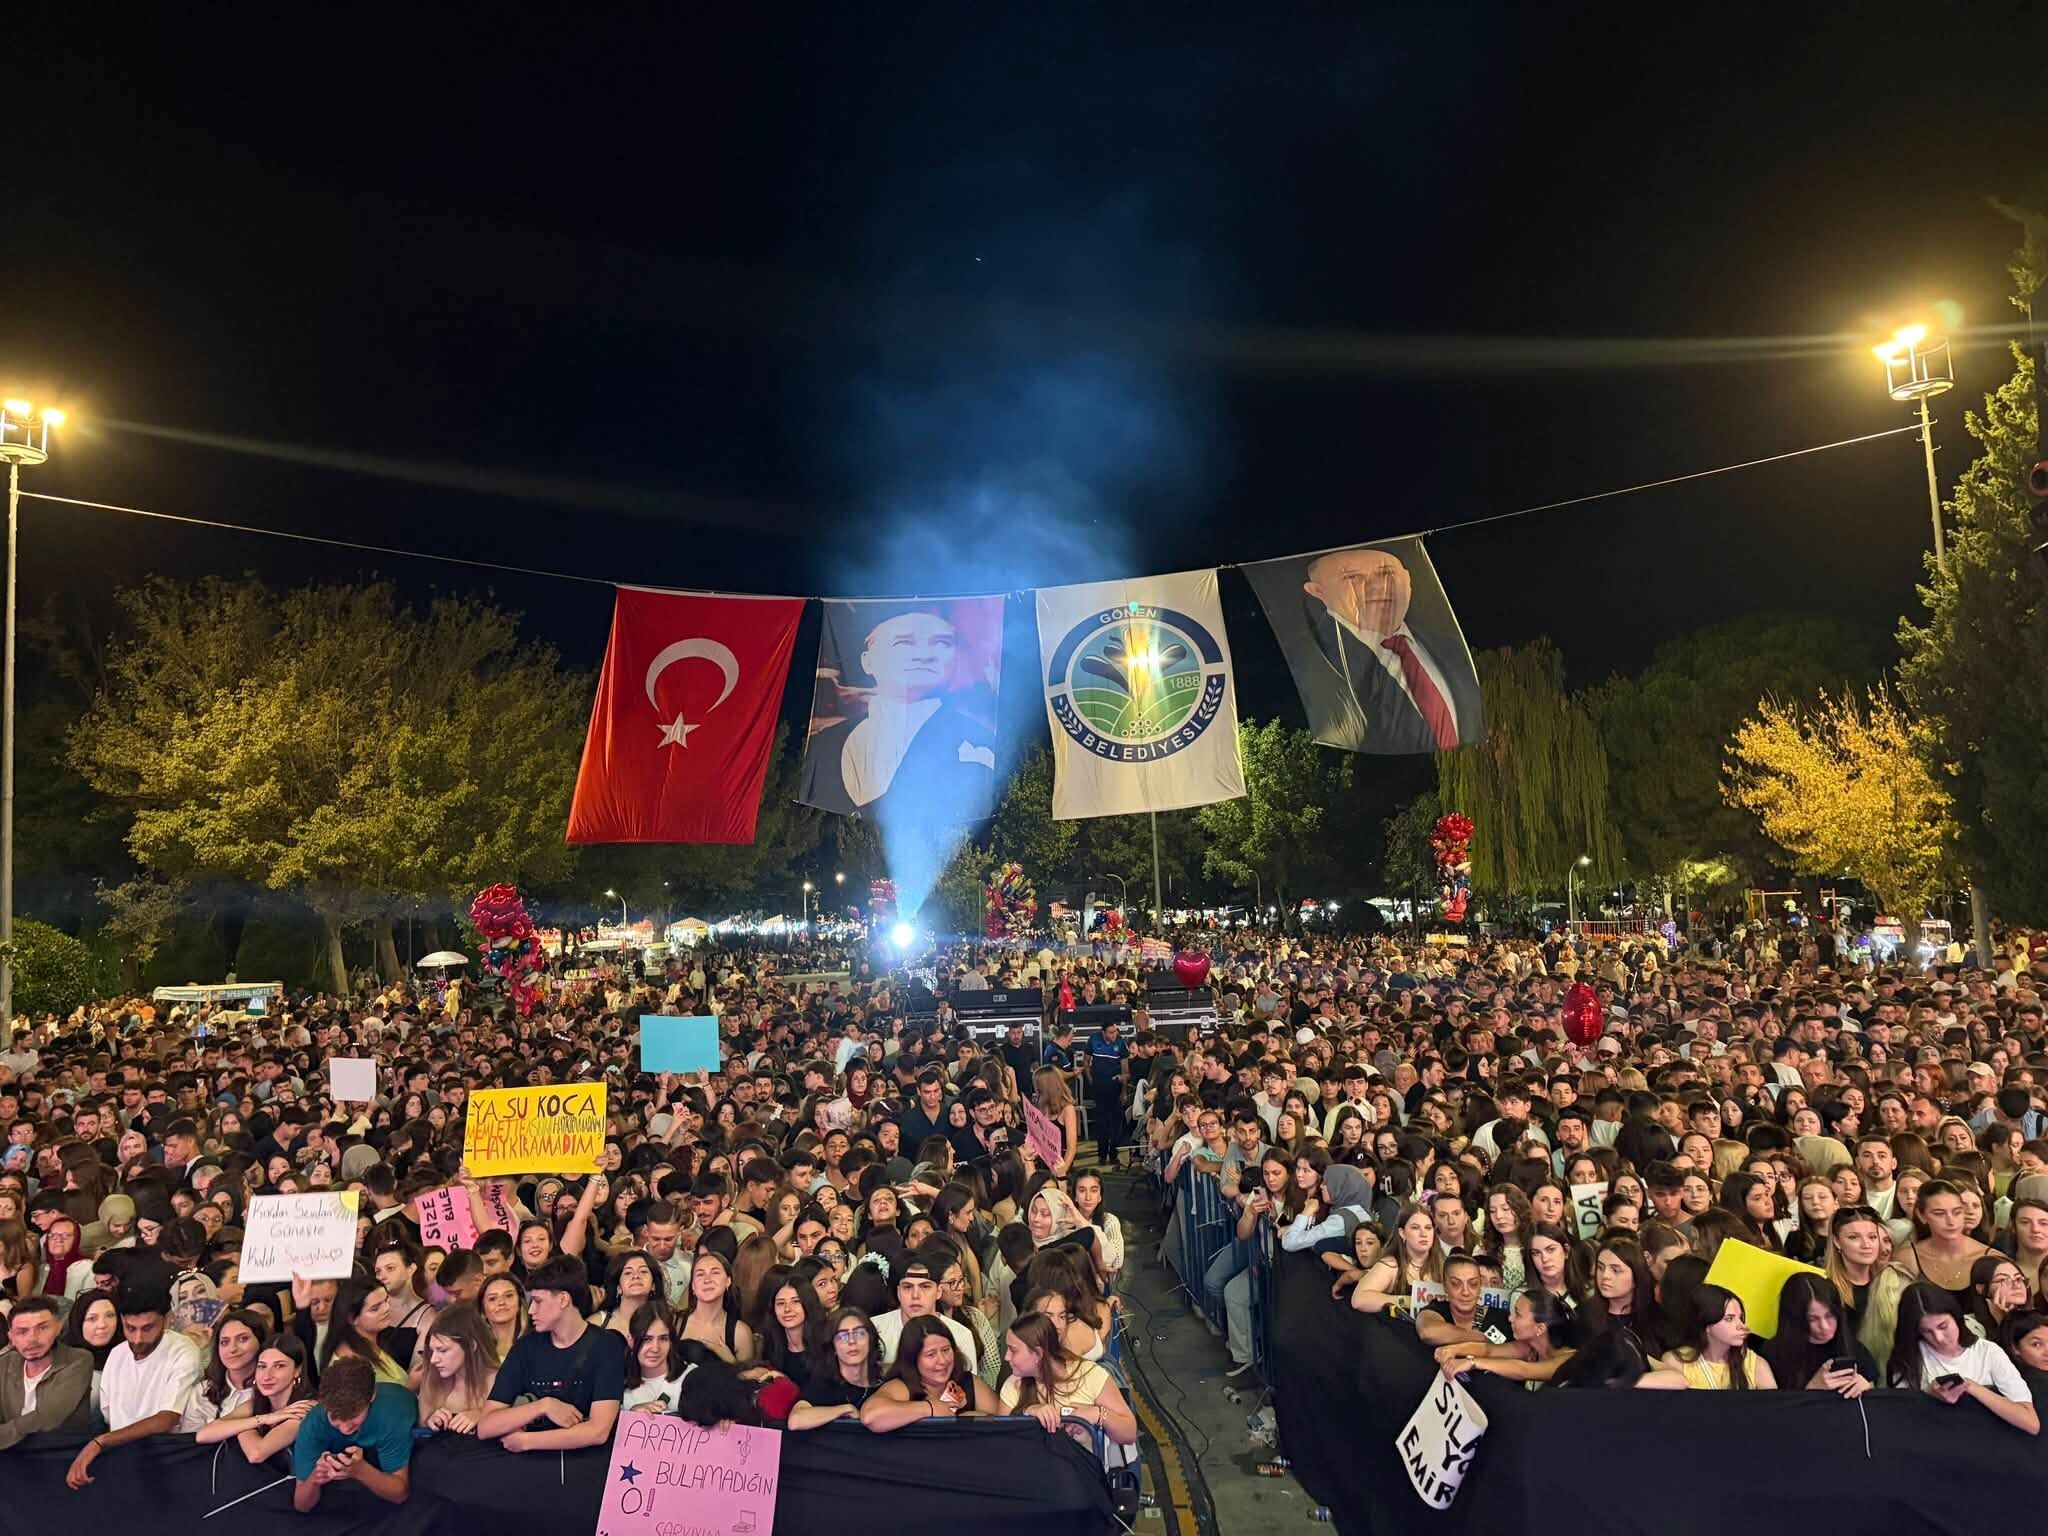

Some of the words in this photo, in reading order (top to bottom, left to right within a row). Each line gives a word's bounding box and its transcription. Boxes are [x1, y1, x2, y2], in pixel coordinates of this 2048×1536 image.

[1099, 607, 1158, 625] GÖNEN
[1169, 674, 1201, 690] 1888
[624, 1420, 710, 1454] ARAYIP
[621, 1487, 656, 1517] O!
